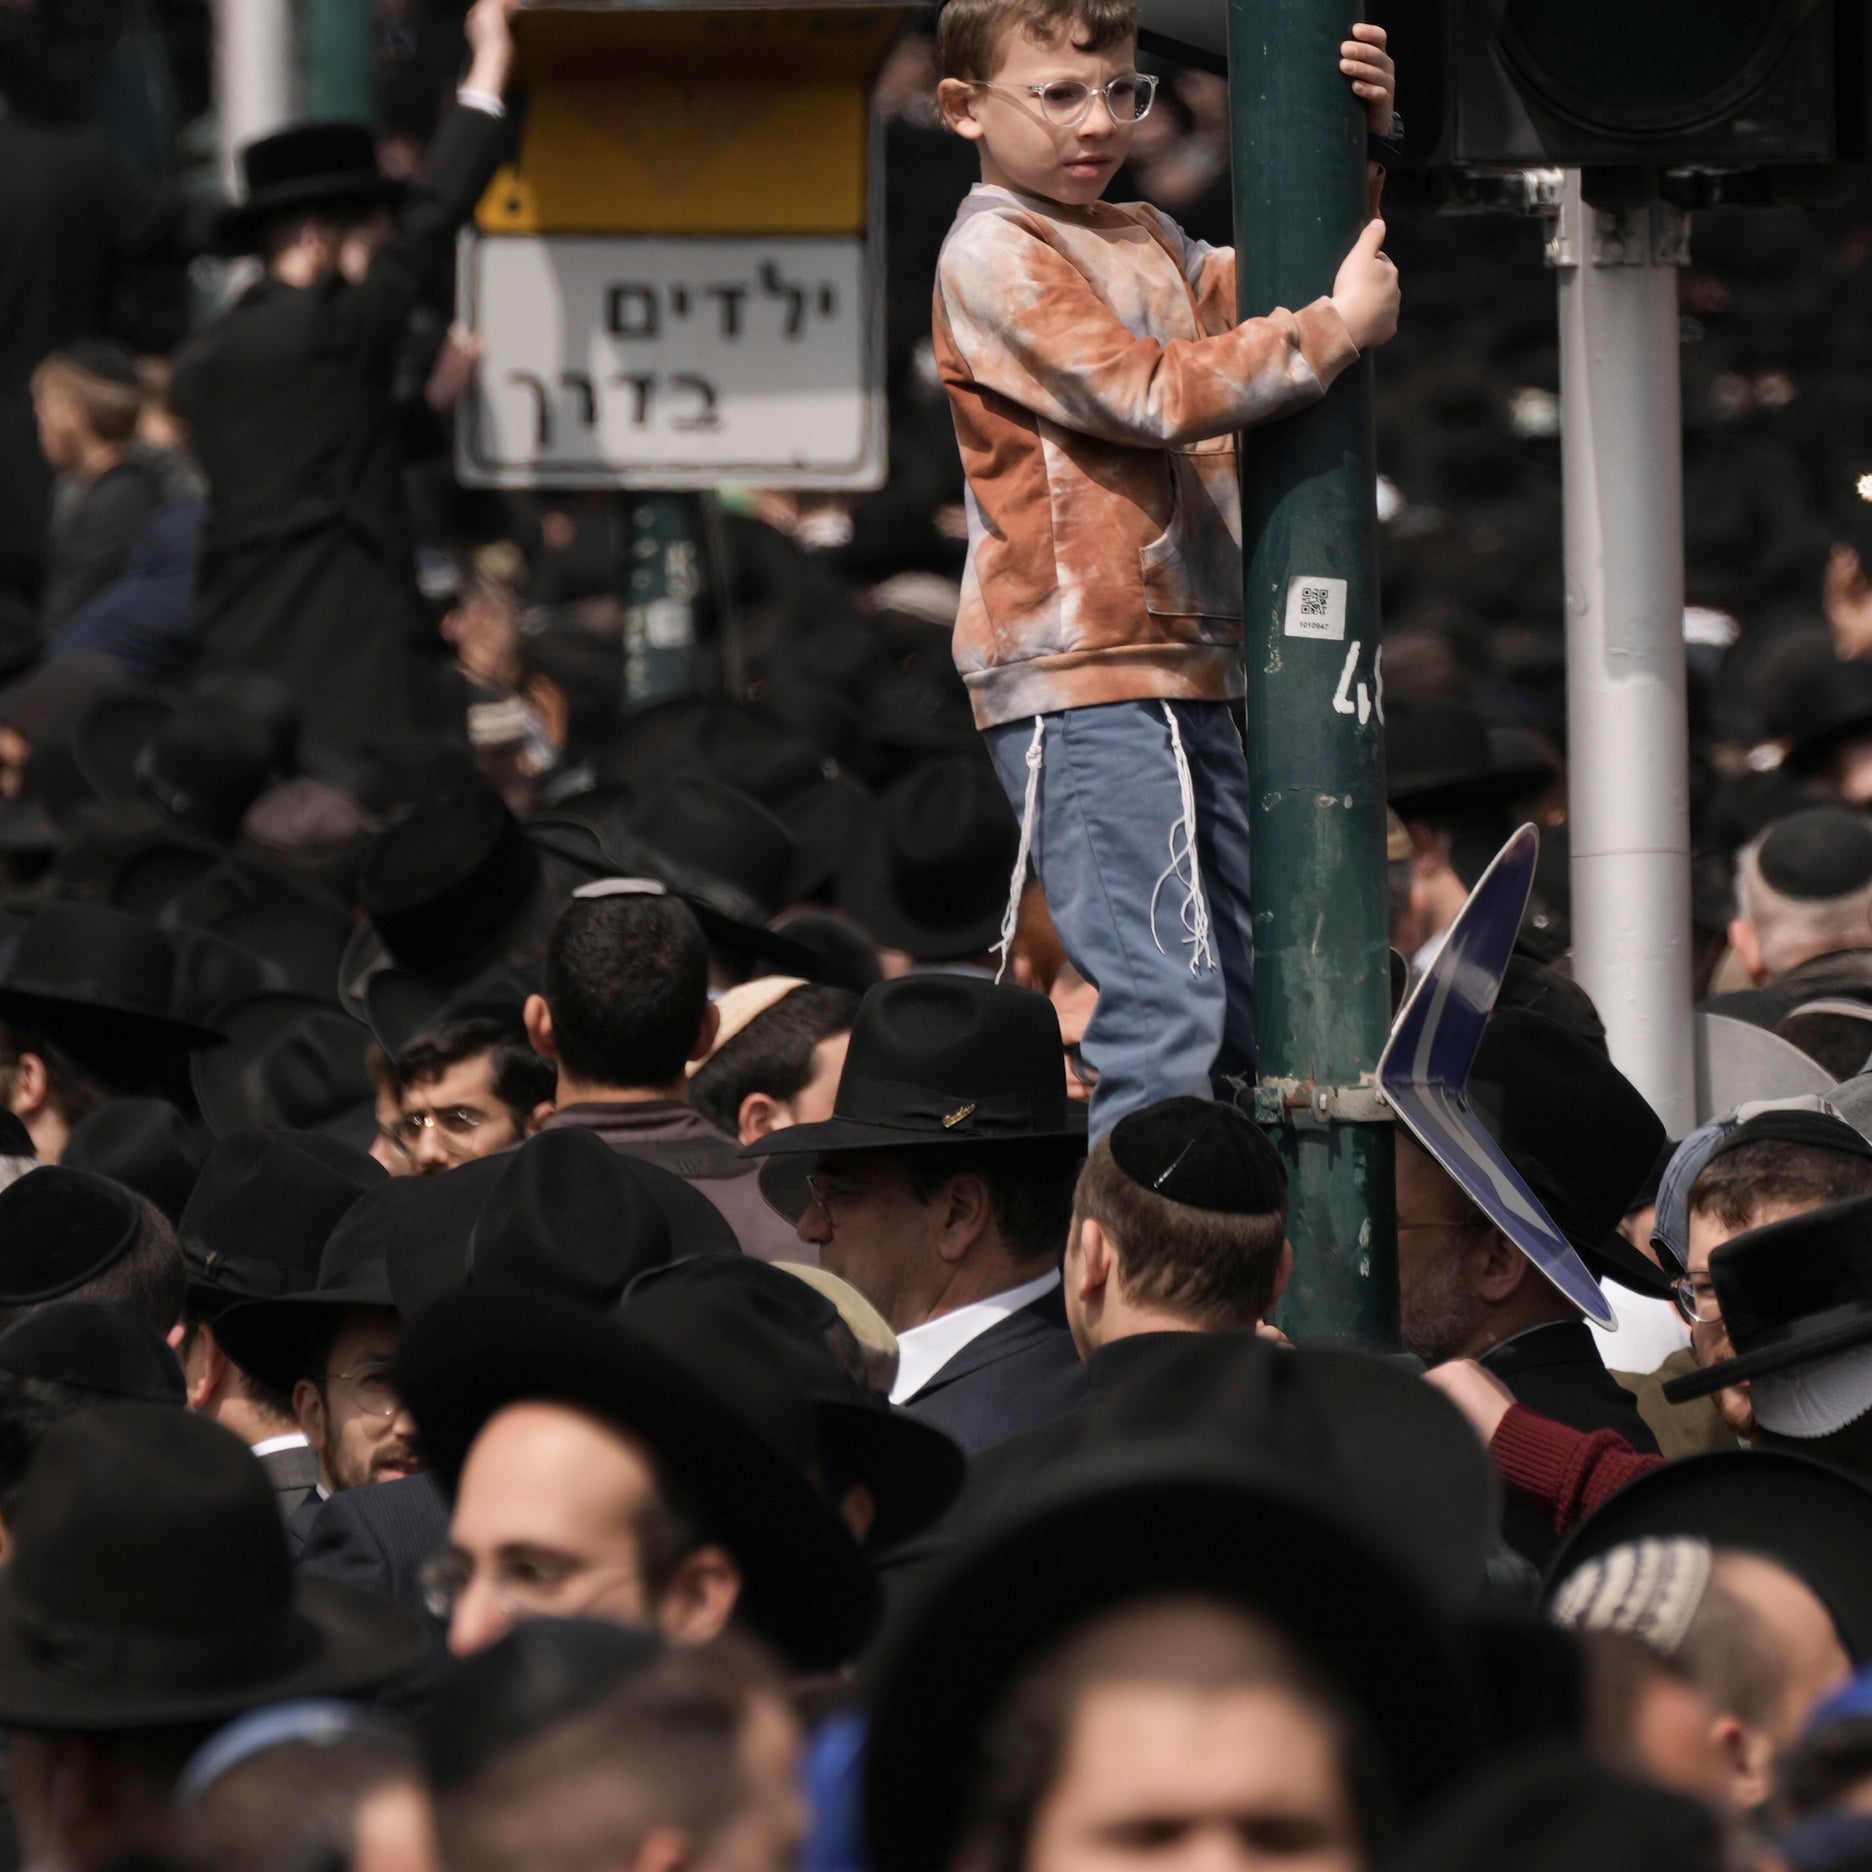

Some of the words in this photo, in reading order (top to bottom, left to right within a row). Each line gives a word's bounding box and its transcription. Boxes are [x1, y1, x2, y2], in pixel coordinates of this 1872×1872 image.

[604, 259, 838, 341] ילדים
[508, 368, 724, 448] בדרך
[1332, 641, 1385, 726] 4
